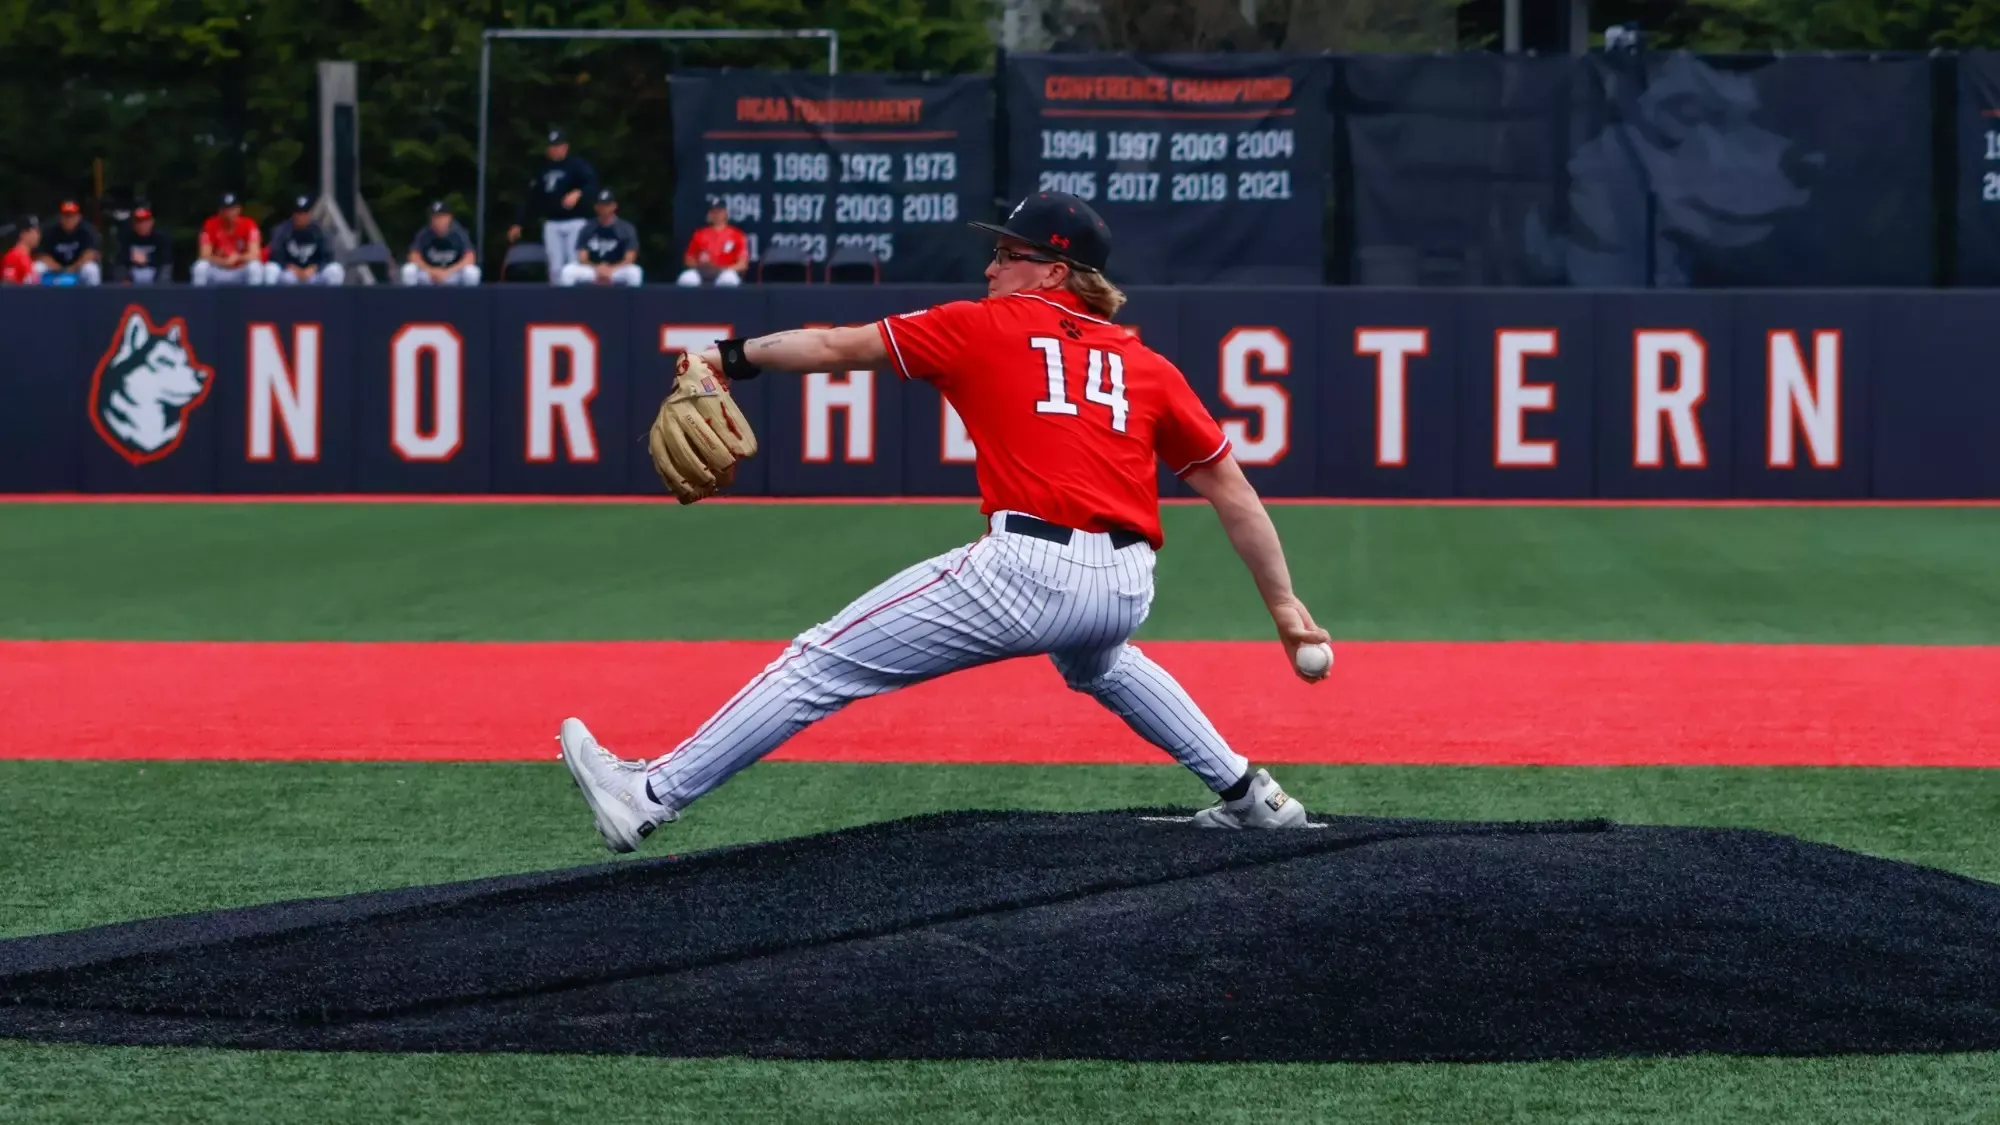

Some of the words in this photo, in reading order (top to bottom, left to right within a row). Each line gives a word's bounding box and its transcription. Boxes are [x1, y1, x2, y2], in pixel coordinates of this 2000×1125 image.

[1045, 76, 1168, 101] CONFERENCE
[1172, 77, 1293, 103] CHAMPIONS
[736, 96, 788, 121] NCAA
[792, 96, 923, 123] TOURNAMENT
[1040, 129, 1097, 160] 1994
[1106, 131, 1161, 161] 1997
[1170, 131, 1228, 162] 2003
[1236, 128, 1294, 159] 2004
[706, 152, 762, 183] 1964
[839, 152, 892, 184] 1972
[903, 151, 957, 183] 1973
[1039, 169, 1097, 202] 2005
[1107, 171, 1161, 202] 2017
[1171, 172, 1228, 202] 2018
[1237, 170, 1293, 201] 2021
[706, 193, 762, 223] 94
[772, 193, 826, 223] 1997
[835, 193, 893, 223] 2003
[902, 192, 958, 223] 2018
[246, 321, 1842, 470] NORHSTERN
[1029, 335, 1130, 434] 14
